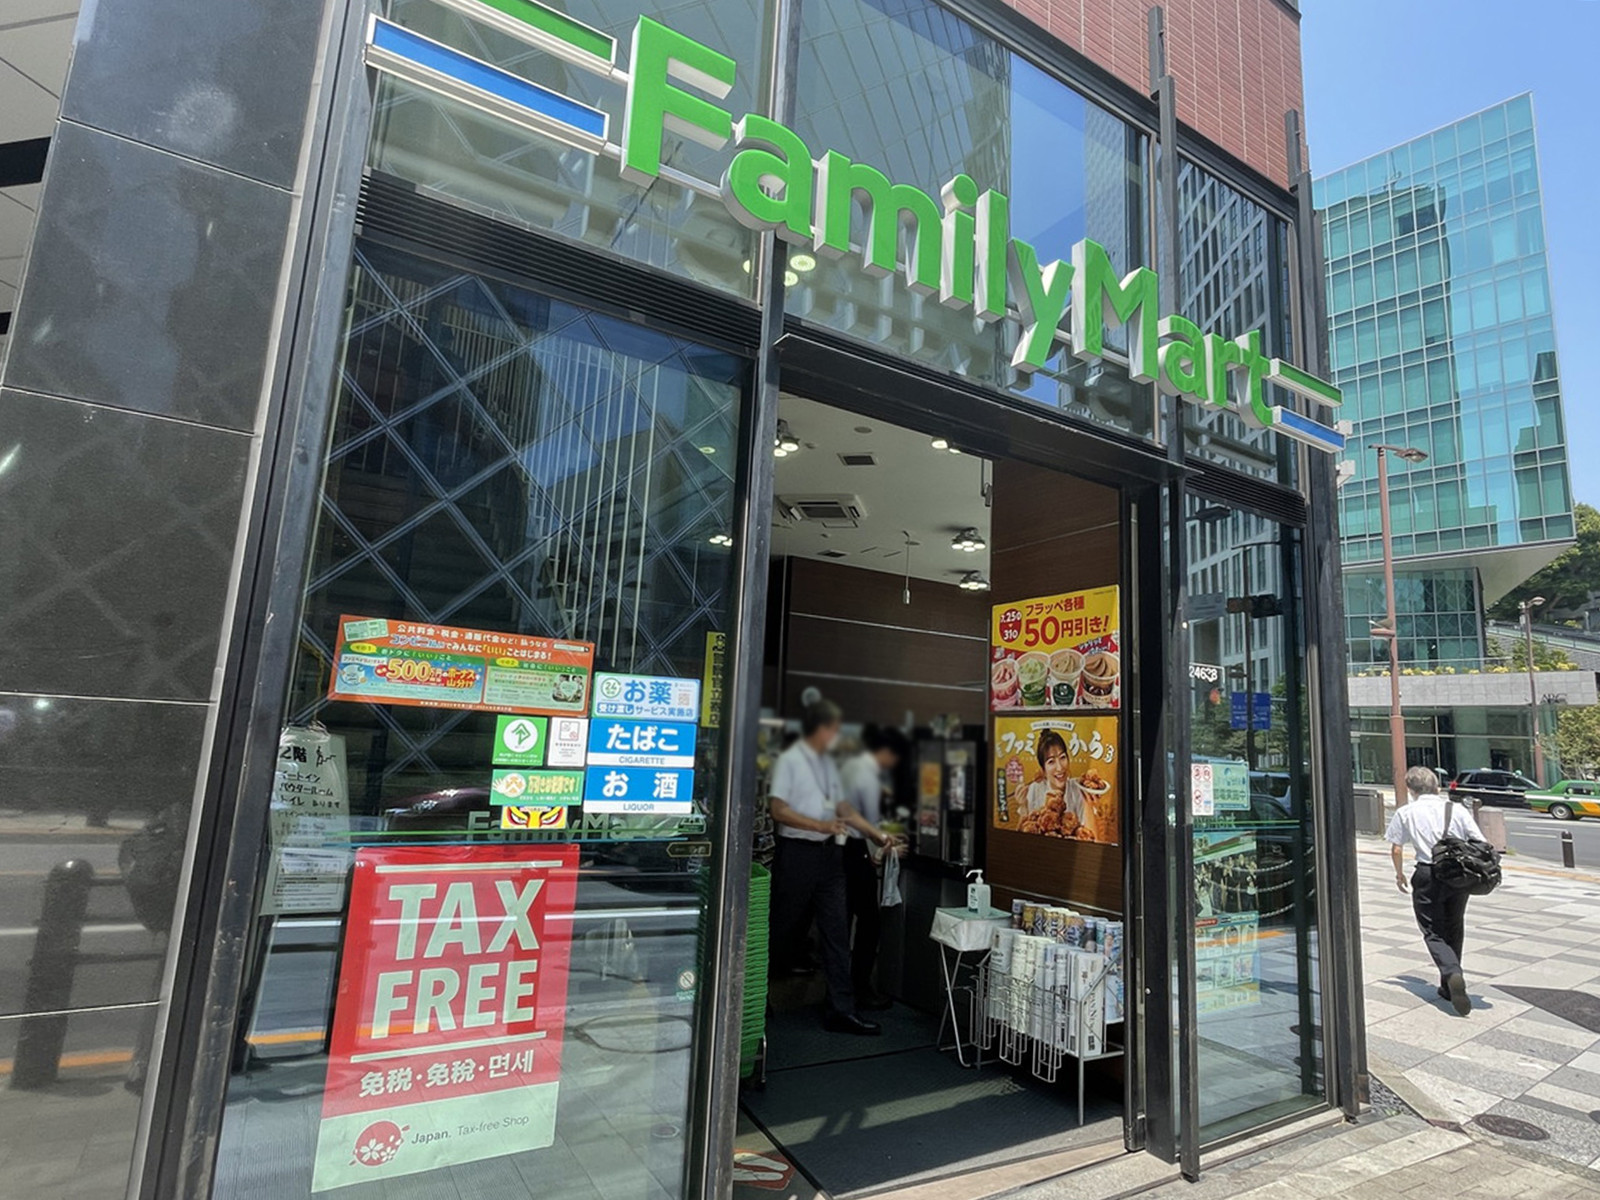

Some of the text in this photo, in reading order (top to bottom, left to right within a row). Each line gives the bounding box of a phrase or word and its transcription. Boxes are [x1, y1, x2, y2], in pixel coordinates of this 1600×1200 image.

[619, 15, 1276, 430] FamilyMart
[623, 679, 673, 705] お薬
[606, 723, 679, 752] たばこ
[618, 755, 666, 765] CIGARETTE
[623, 803, 655, 812] LIQUOR
[388, 878, 546, 961] TAX
[370, 959, 538, 1040] FREE
[502, 1115, 530, 1130] Shop
